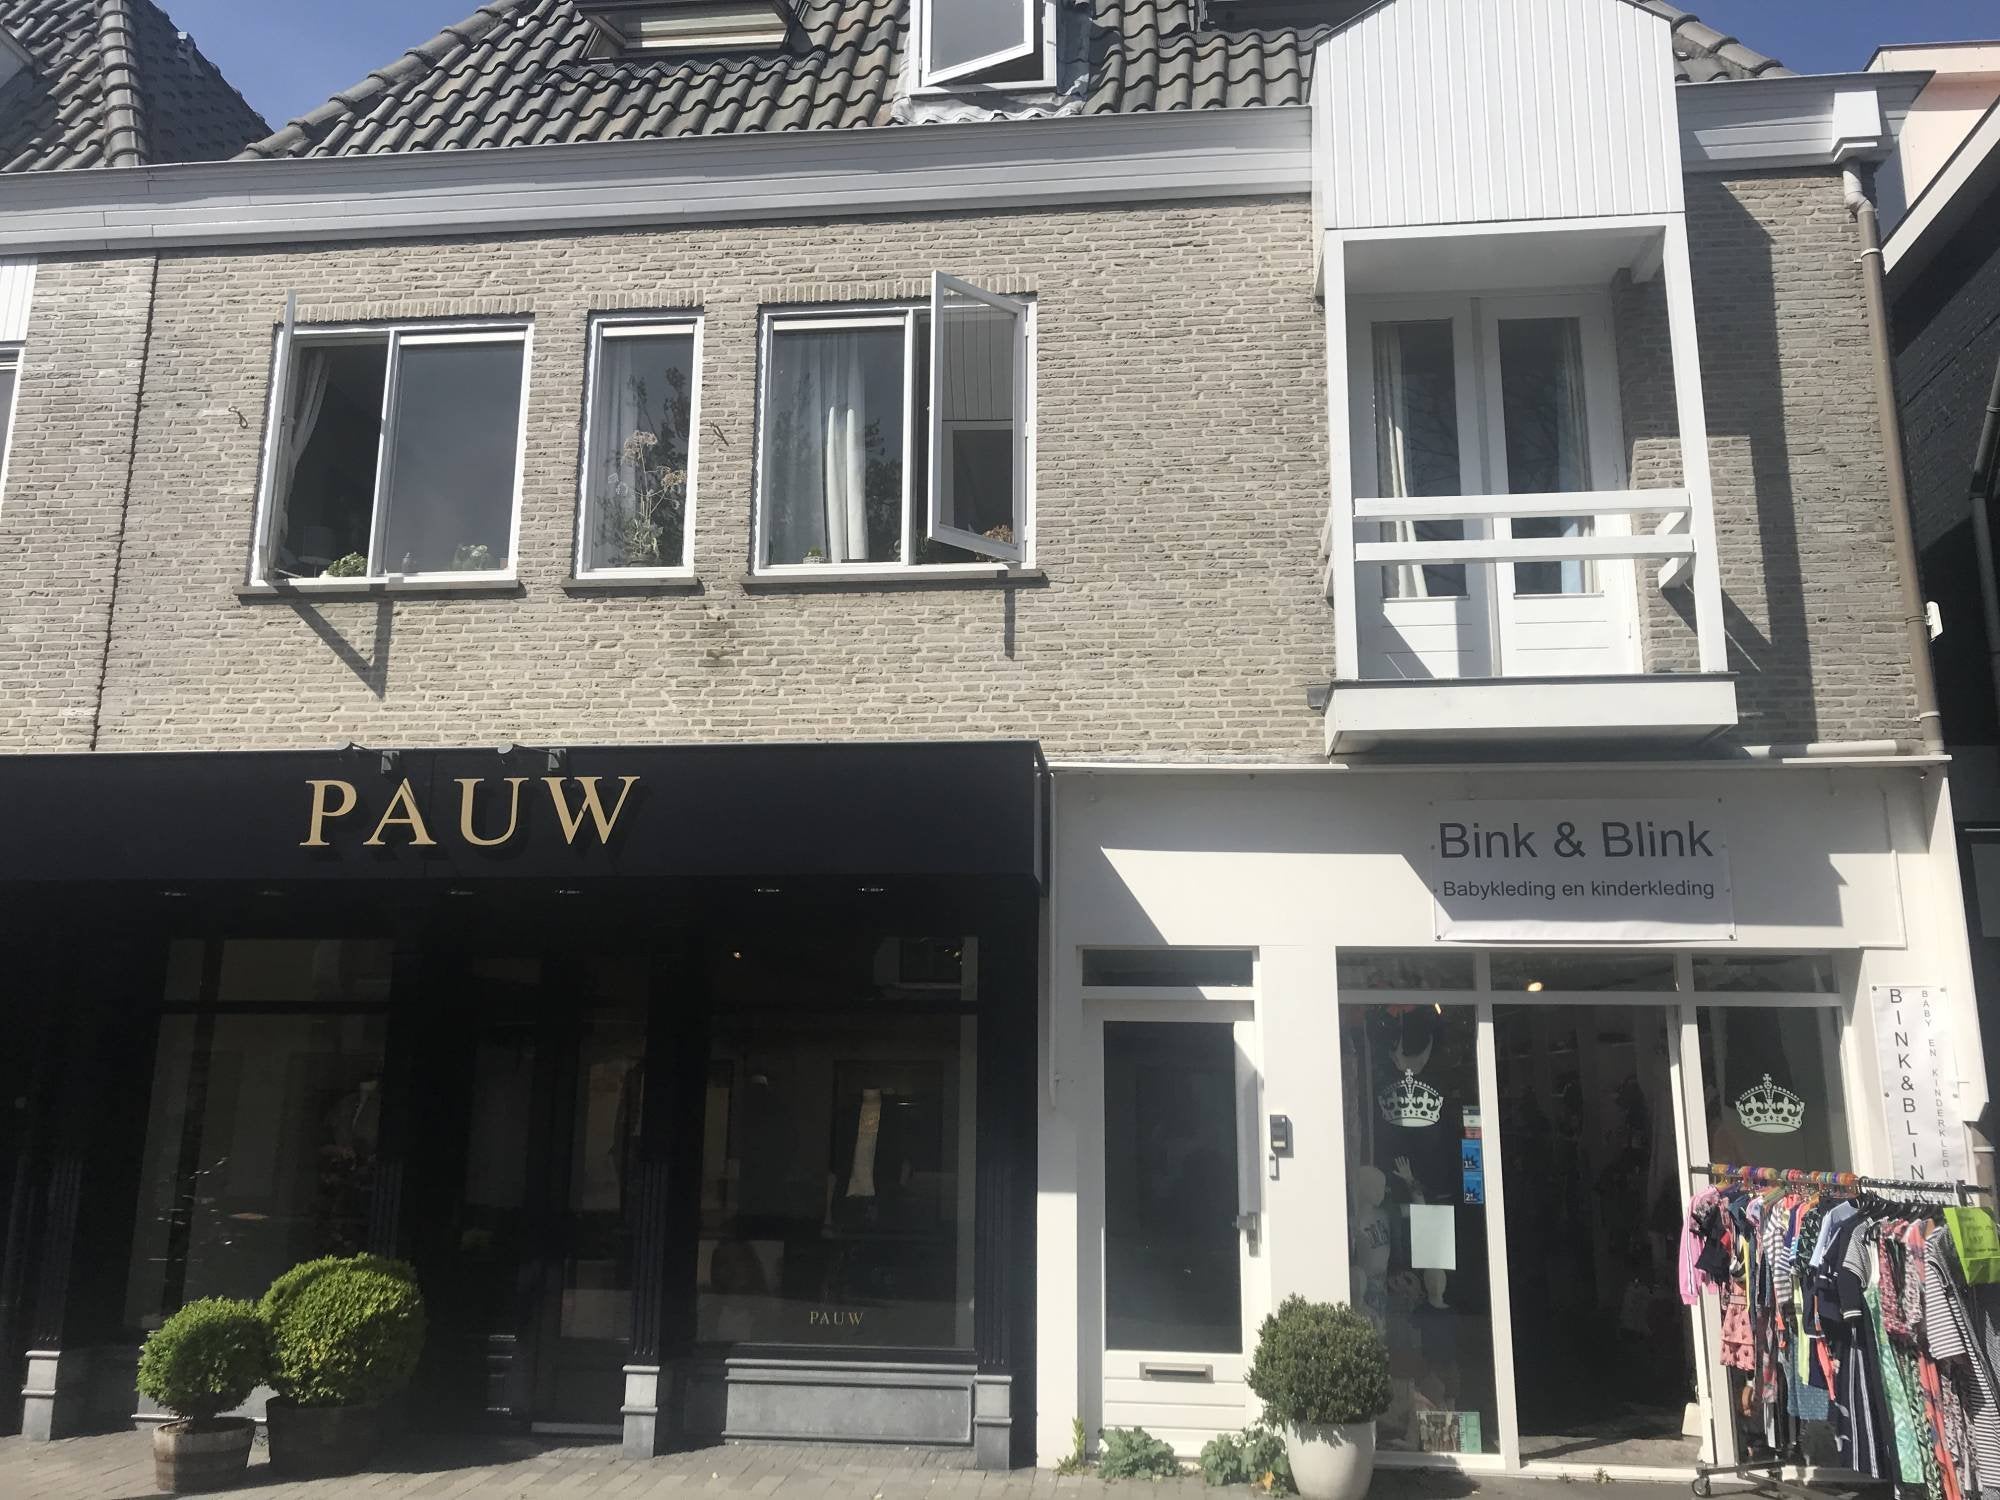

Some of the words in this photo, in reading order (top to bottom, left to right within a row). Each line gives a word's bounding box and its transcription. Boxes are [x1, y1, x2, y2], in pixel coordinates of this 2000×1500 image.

[299, 775, 641, 847] PAUW
[1439, 822, 1538, 858] Bink
[1553, 821, 1587, 857] &
[1602, 820, 1714, 857] Blink
[1443, 881, 1556, 900] Babykleding
[1562, 884, 1585, 896] en
[1591, 880, 1715, 899] kinderkleding
[1921, 990, 1931, 1027] BABY
[1928, 1039, 1937, 1057] EN
[1932, 1069, 1954, 1202] KINDERKLEDI
[809, 1311, 864, 1325] PAUW
